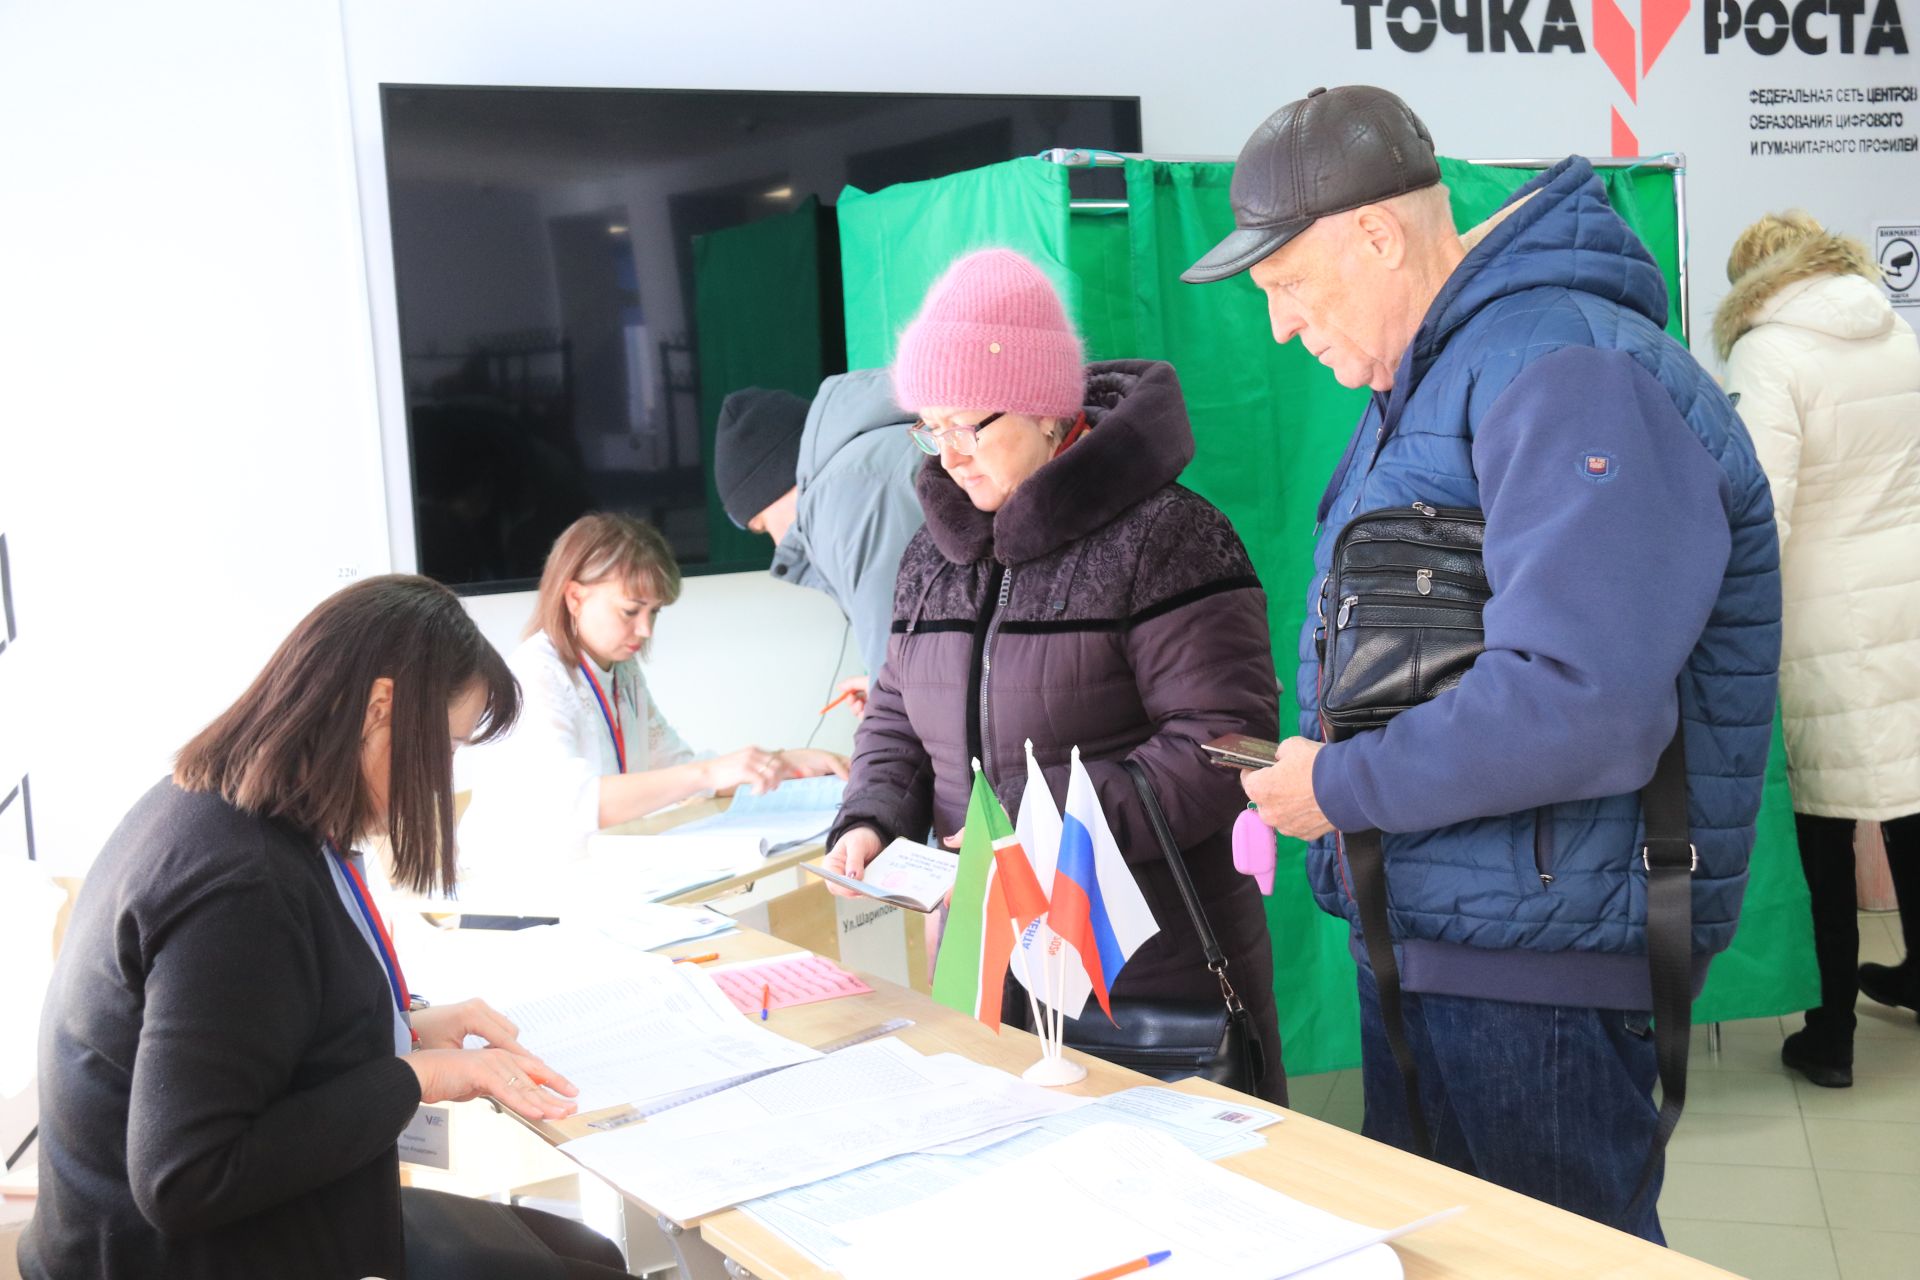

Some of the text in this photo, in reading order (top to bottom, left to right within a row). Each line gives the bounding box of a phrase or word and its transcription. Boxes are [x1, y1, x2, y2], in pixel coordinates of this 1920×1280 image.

[1341, 0, 1909, 55] ТОЧКА РОСТА
[1750, 86, 1917, 106] ФЕДЕРАЛЬНАЯ СЕТЬ ЦЕНТРОВ
[1750, 112, 1903, 130] ОБРАЗОВАНИЯ ЦИФРОВОГО
[1750, 135, 1918, 155] И ГУМАНИТАРНОГО ПРОФИЛЕЙ
